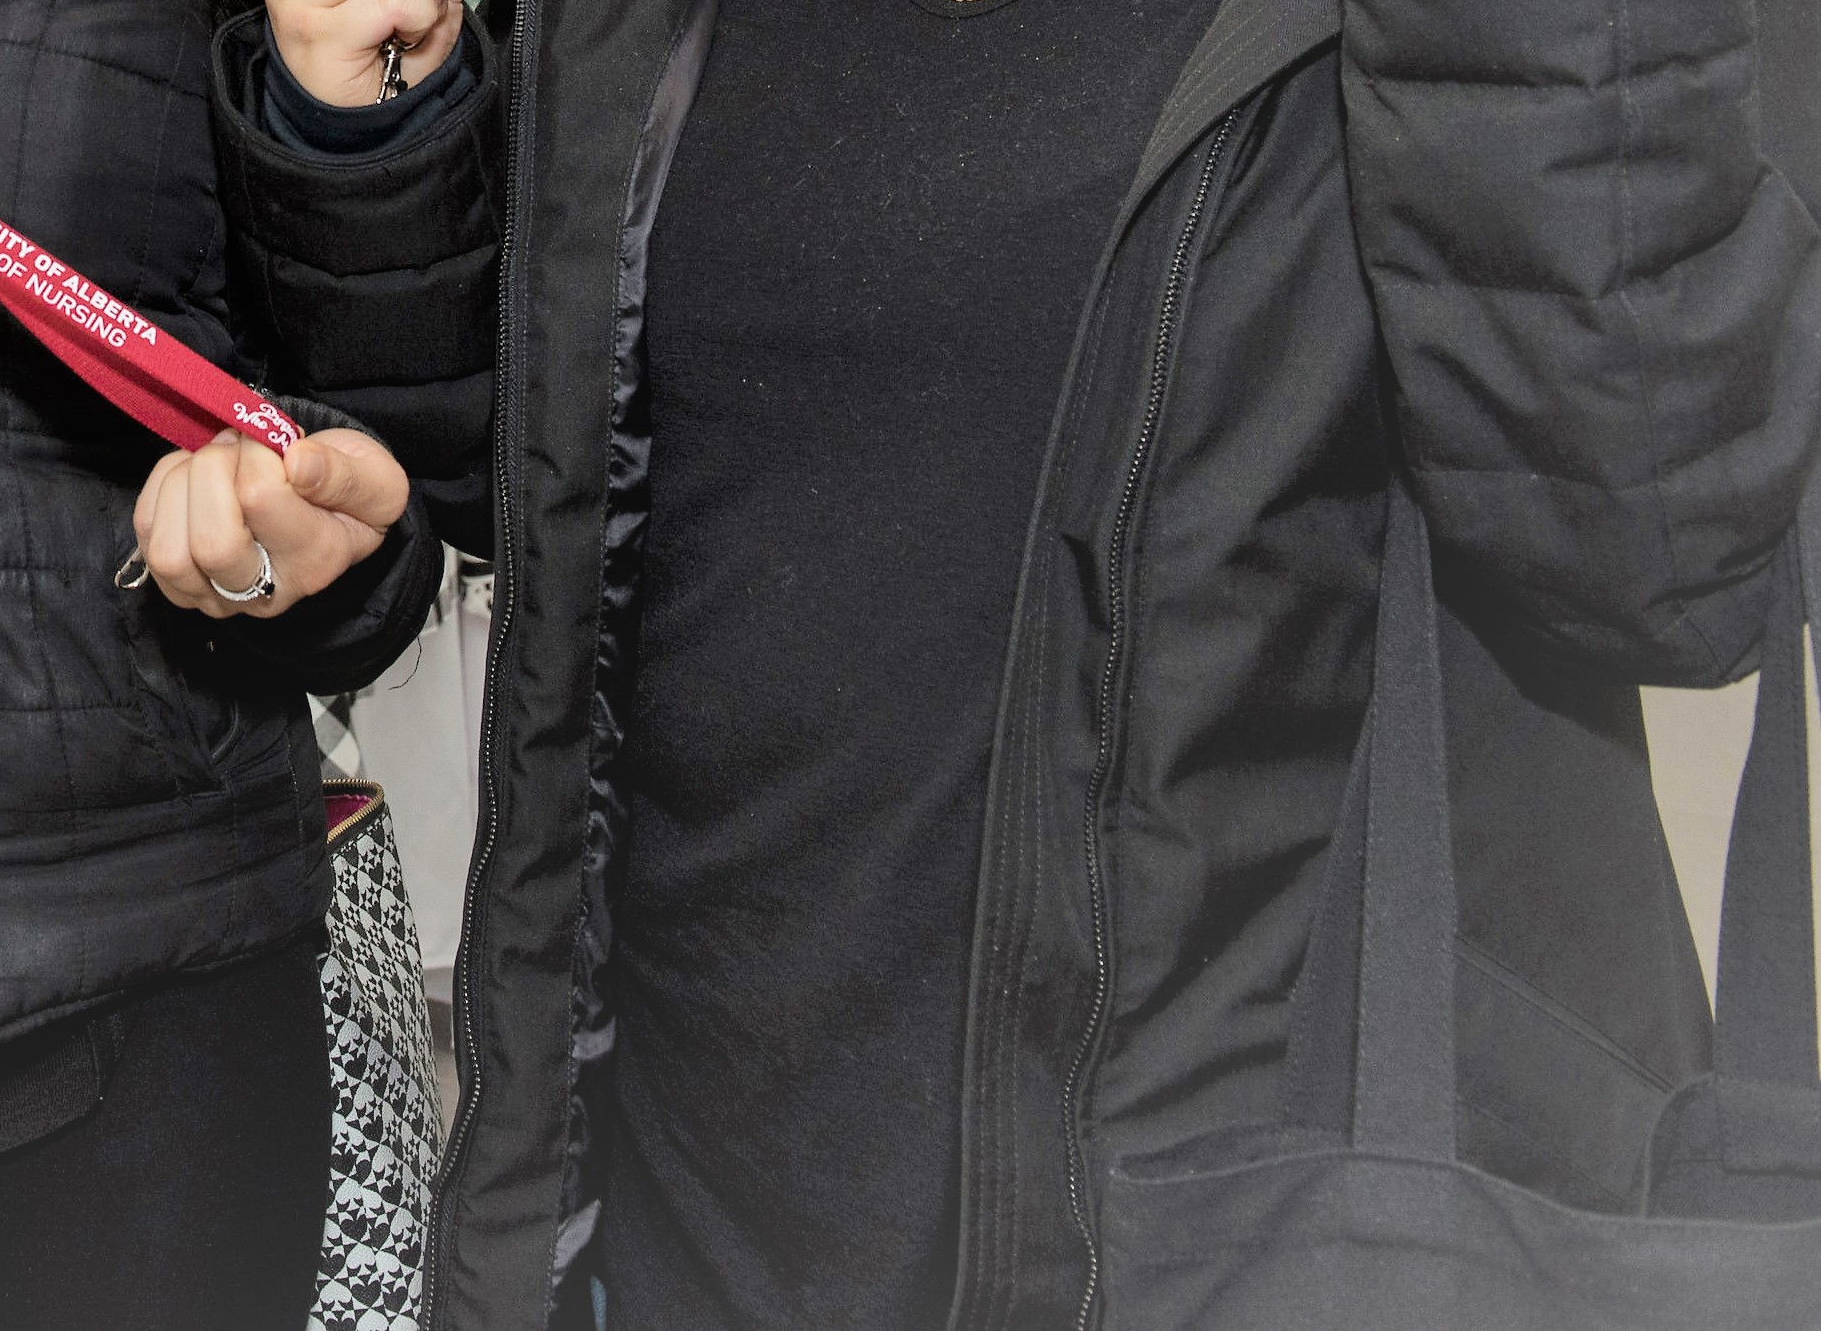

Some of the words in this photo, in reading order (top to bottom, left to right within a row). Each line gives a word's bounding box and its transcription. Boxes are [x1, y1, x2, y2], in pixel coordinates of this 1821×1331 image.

[25, 273, 127, 348] NURSING
[34, 254, 66, 277] OF
[62, 275, 157, 345] ALBERTA
